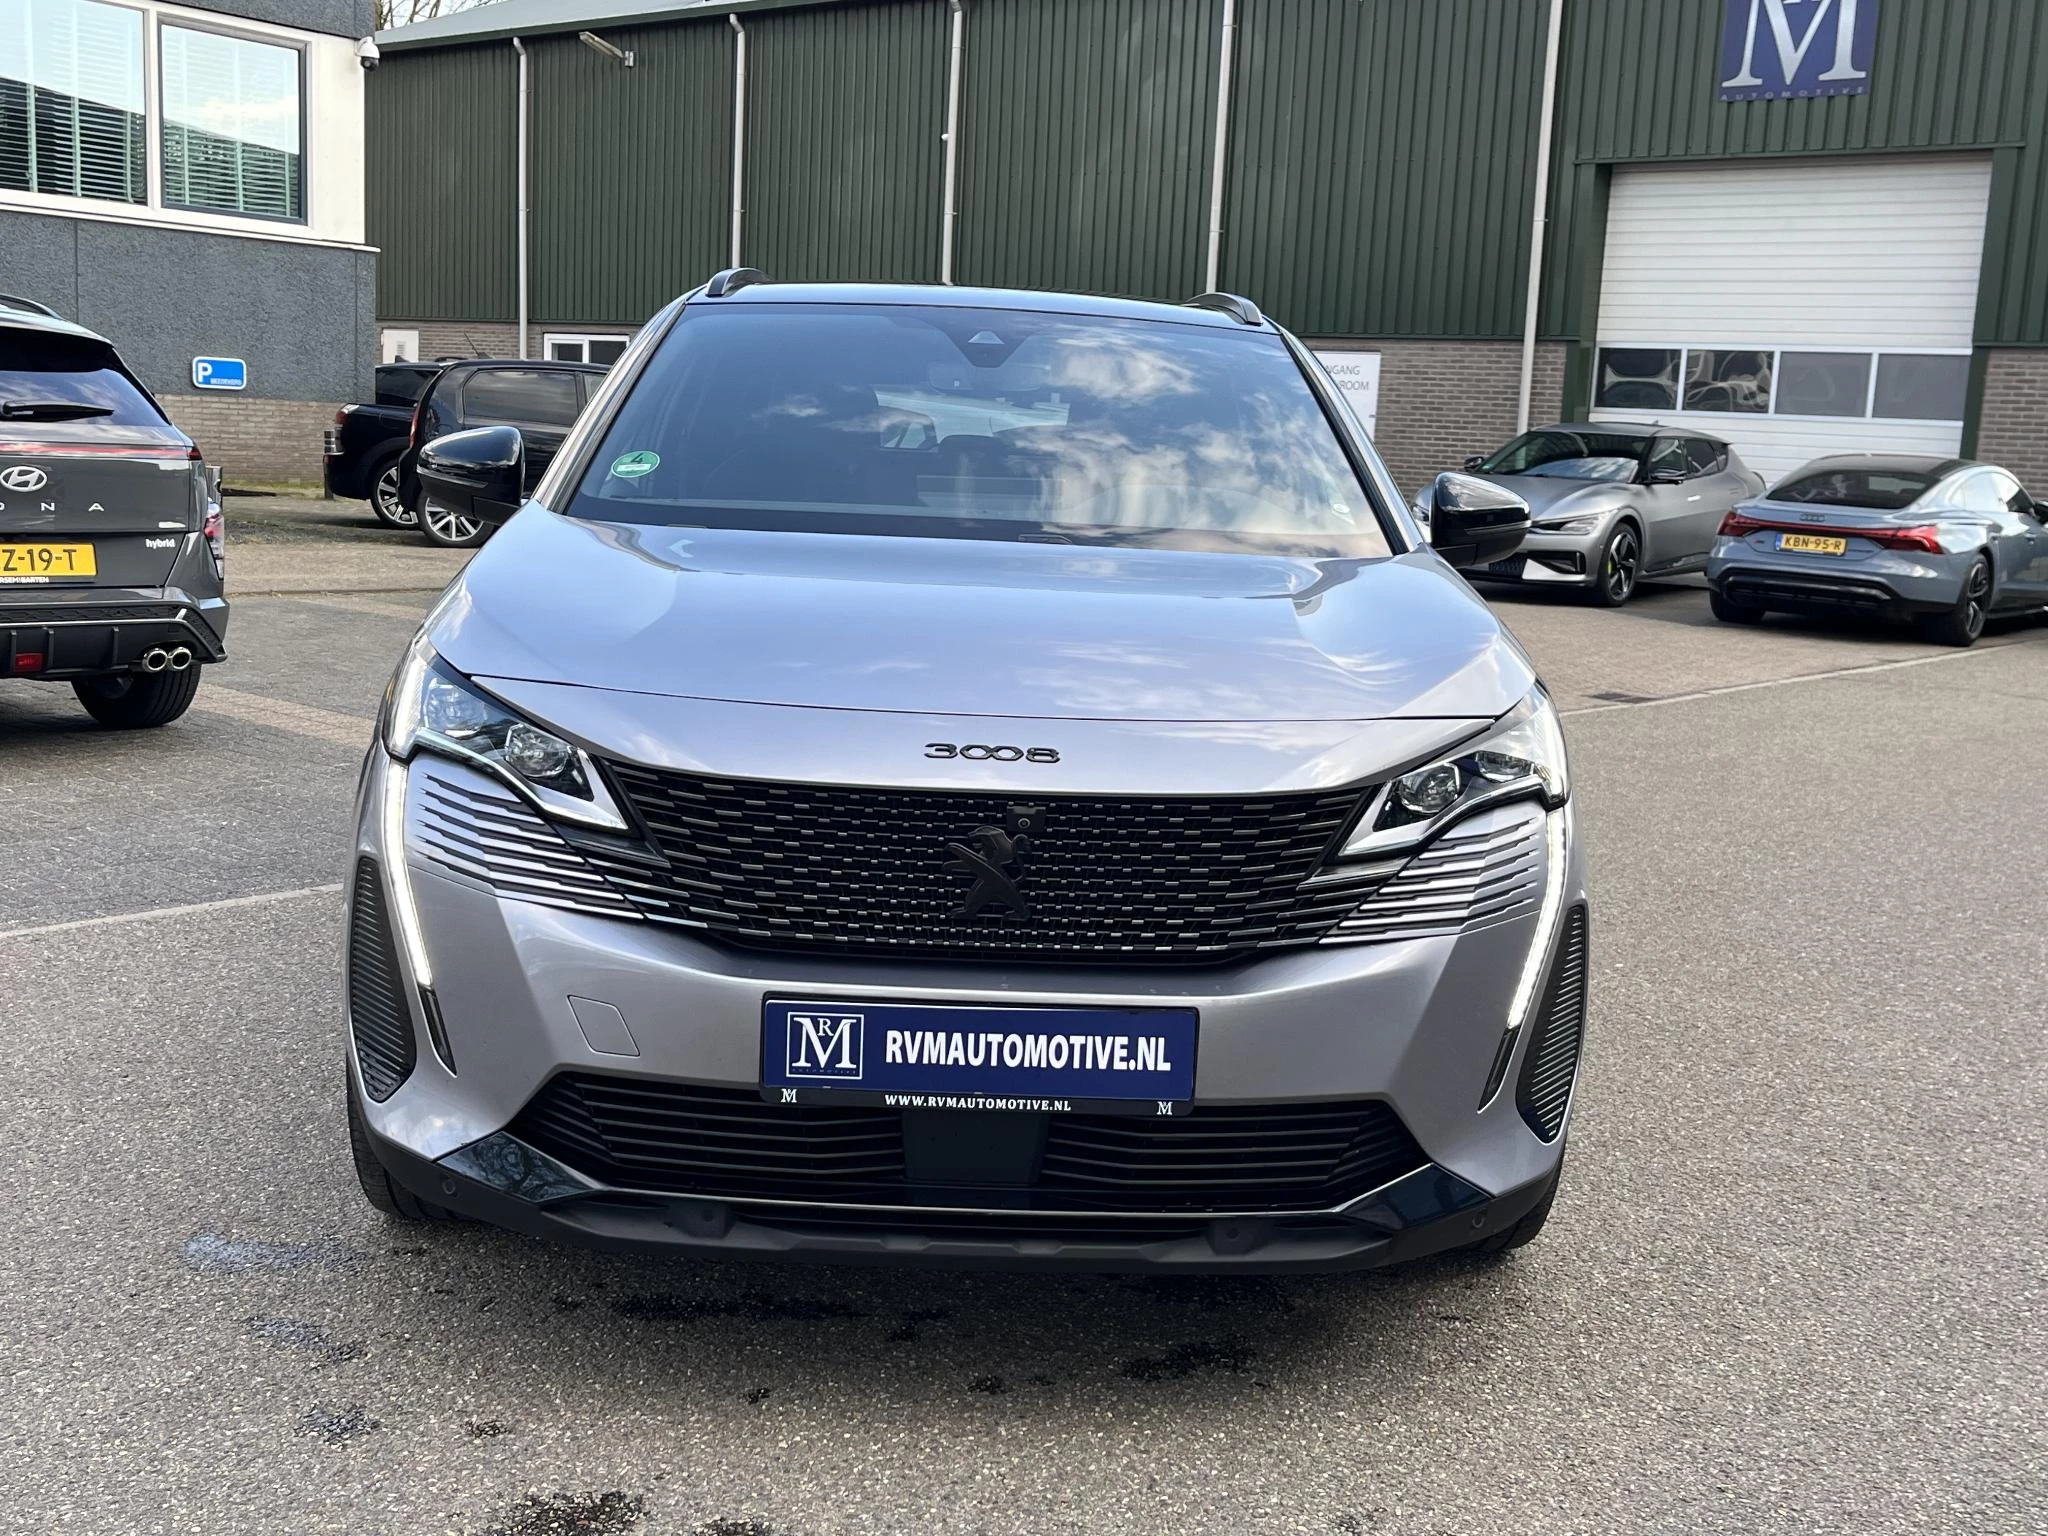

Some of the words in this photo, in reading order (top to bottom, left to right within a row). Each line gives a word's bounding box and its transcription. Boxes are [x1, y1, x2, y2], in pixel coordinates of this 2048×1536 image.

[197, 362, 213, 383] P
[145, 538, 176, 550] hybrid
[1784, 537, 1842, 551] KBN-95-R
[924, 743, 1061, 763] 3008
[885, 1030, 1172, 1072] RVMAUTOMOTIVE.NL
[884, 1094, 1072, 1111] WWW.RVMAUTOMOTIVE.NL
